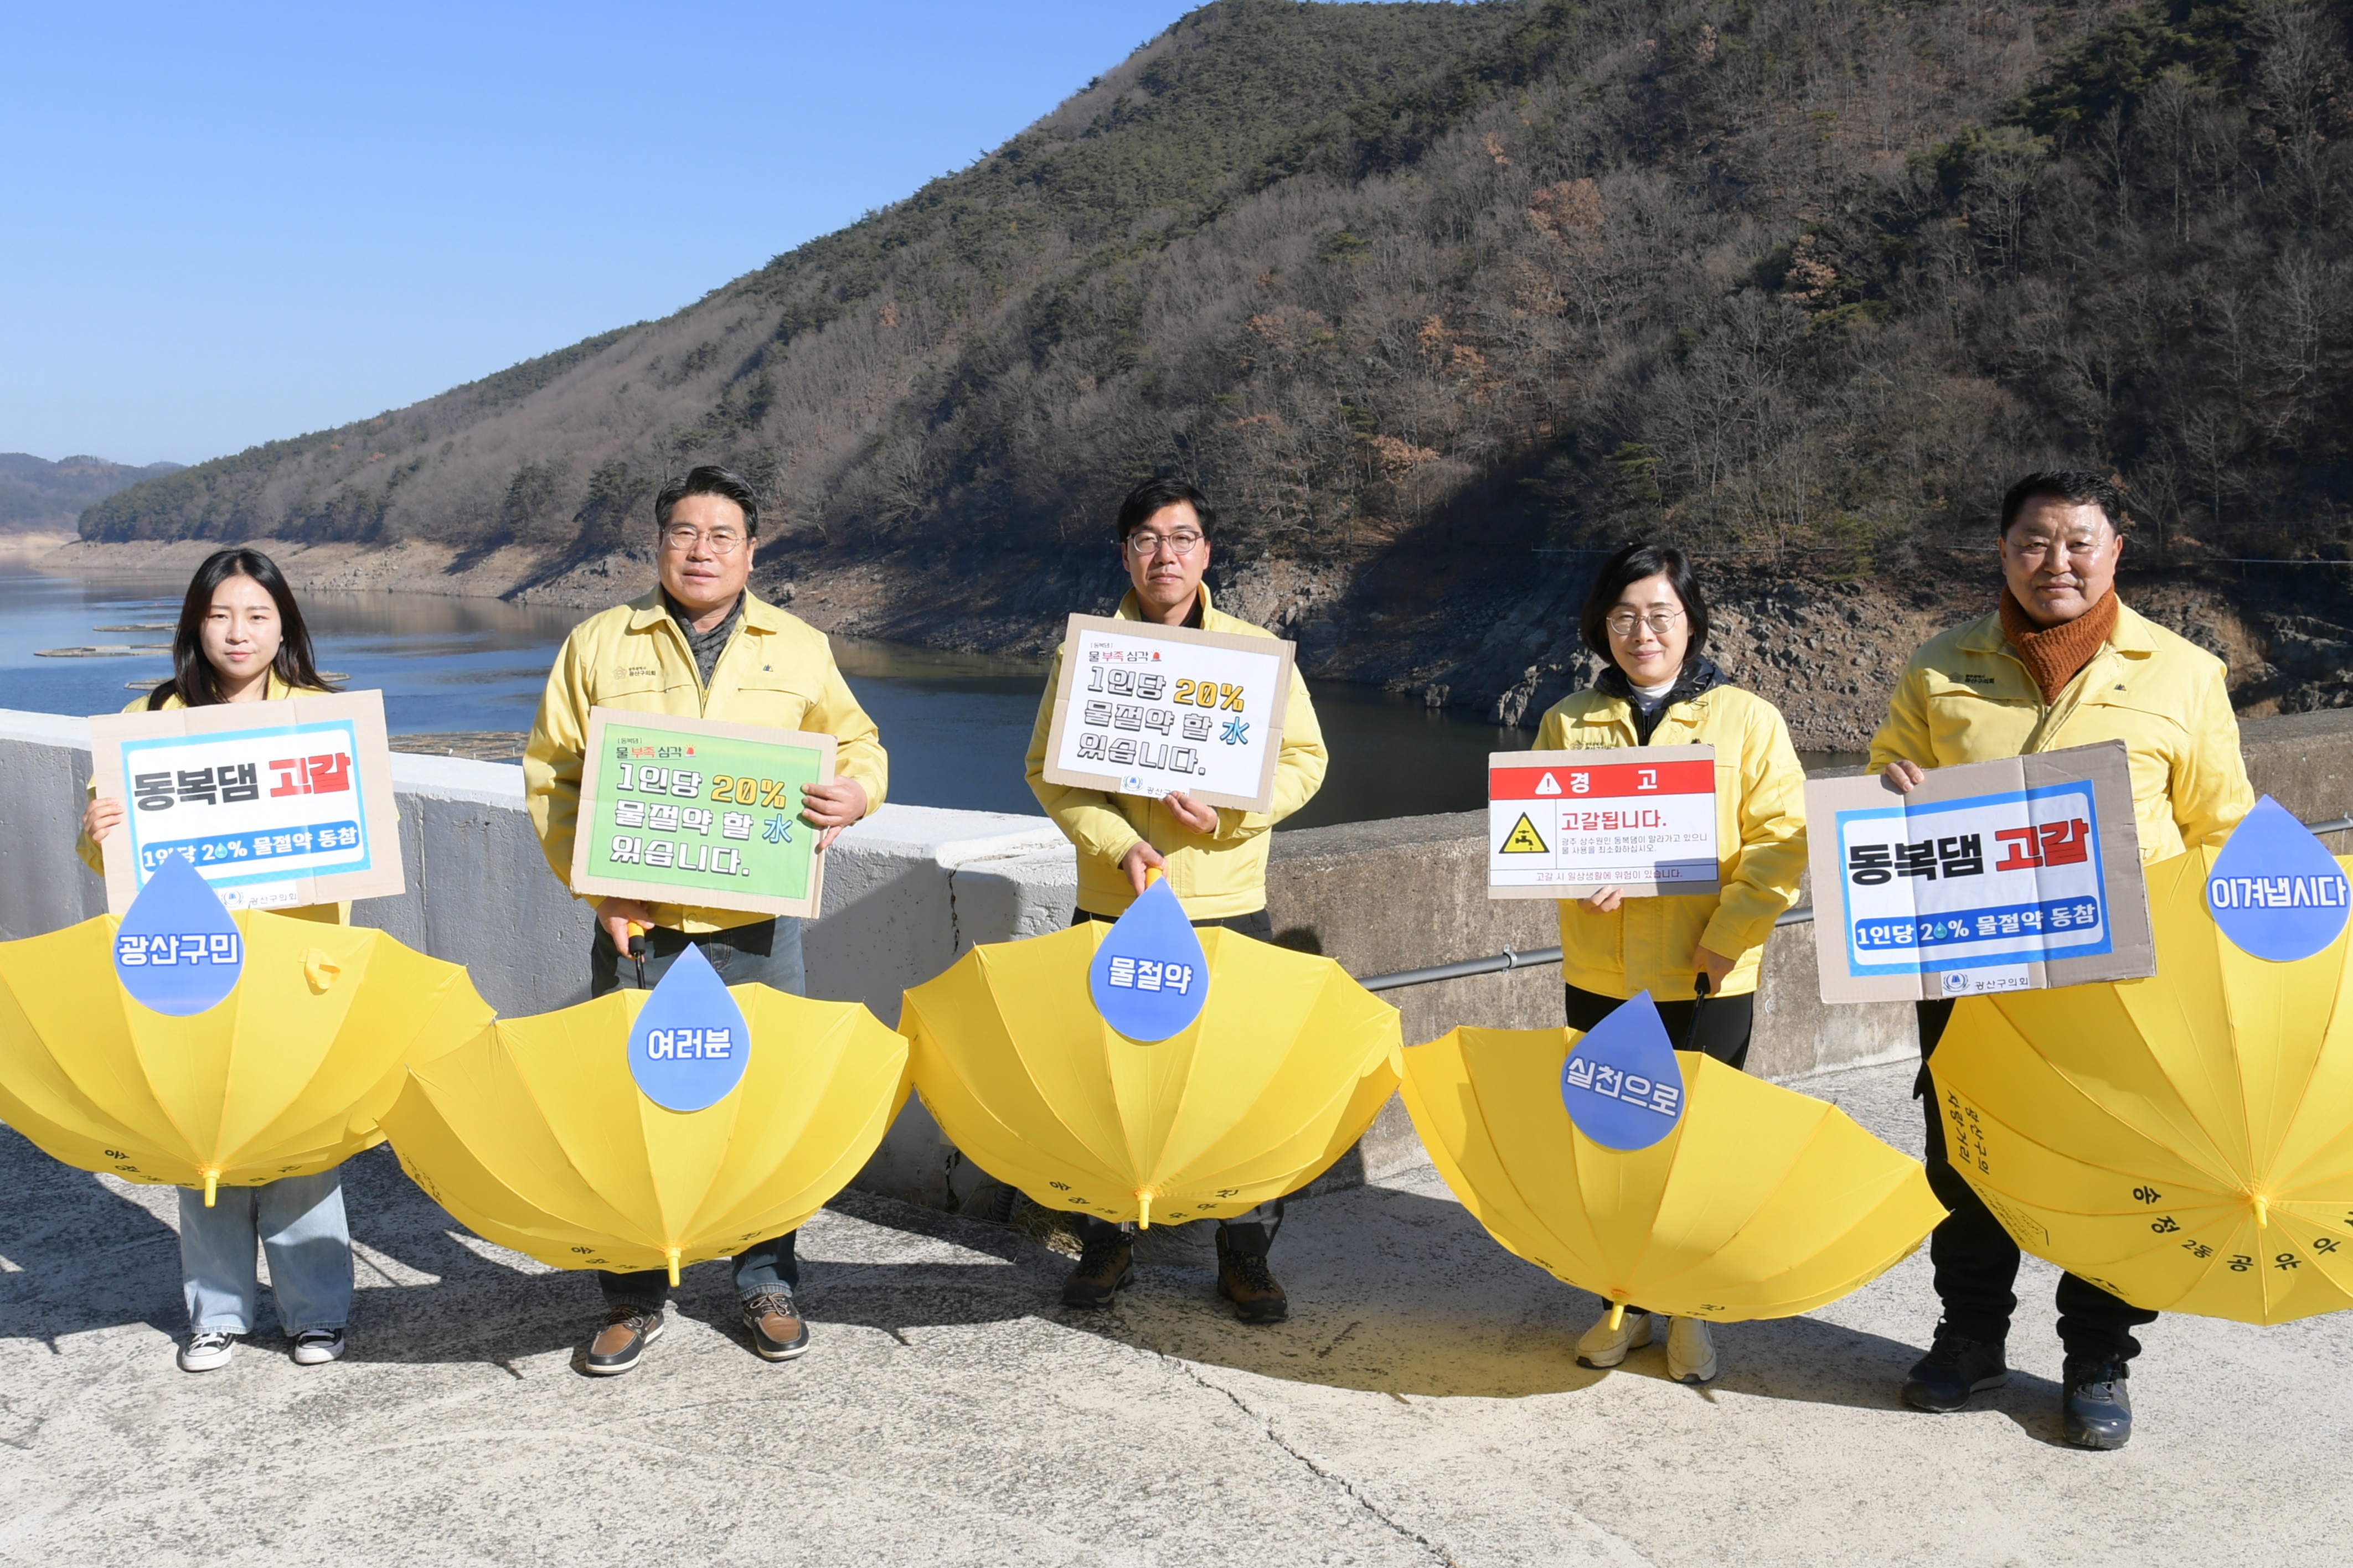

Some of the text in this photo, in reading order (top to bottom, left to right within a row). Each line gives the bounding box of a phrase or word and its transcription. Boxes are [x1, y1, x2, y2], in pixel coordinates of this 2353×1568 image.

[1088, 651, 1148, 662] 물 부족 심각
[1087, 666, 1244, 712] 1인당 20%
[1084, 700, 1249, 744] 물절약 할 水
[616, 746, 682, 759] 물 부족 심각
[1077, 732, 1206, 776] 있습니다.
[134, 752, 350, 811] 동복댐 고갈
[617, 763, 786, 809] 1인당 20%
[615, 799, 793, 843] 물절약 할 水
[1561, 809, 1666, 831] 고갈됩니다.
[252, 832, 313, 857] 물절약
[317, 826, 358, 848] 동참
[610, 835, 750, 876] 있습니다.
[1580, 837, 1611, 846] 상수원인
[1614, 836, 1645, 845] 동복댐이
[1648, 834, 1680, 843] 말라가고
[1684, 833, 1707, 842] 있으니
[1598, 844, 1657, 853] 최소화하십시오.
[1849, 818, 2089, 886] 동복댐 고갈
[1536, 869, 1683, 881] 고갈 시 일상생활에 위험이 있습니다.
[250, 893, 297, 905] 광산구의회
[2211, 876, 2346, 908] 이겨냅시다
[1857, 924, 1914, 945] 1인당
[1975, 913, 2044, 936] 물절약
[2050, 904, 2096, 928] 동참
[118, 933, 239, 966] 광산구민
[1109, 956, 1193, 995] 물절약
[1975, 977, 2028, 990] 광산구의회
[648, 1029, 731, 1060] 여러분
[1567, 1057, 1680, 1117] 실천으로
